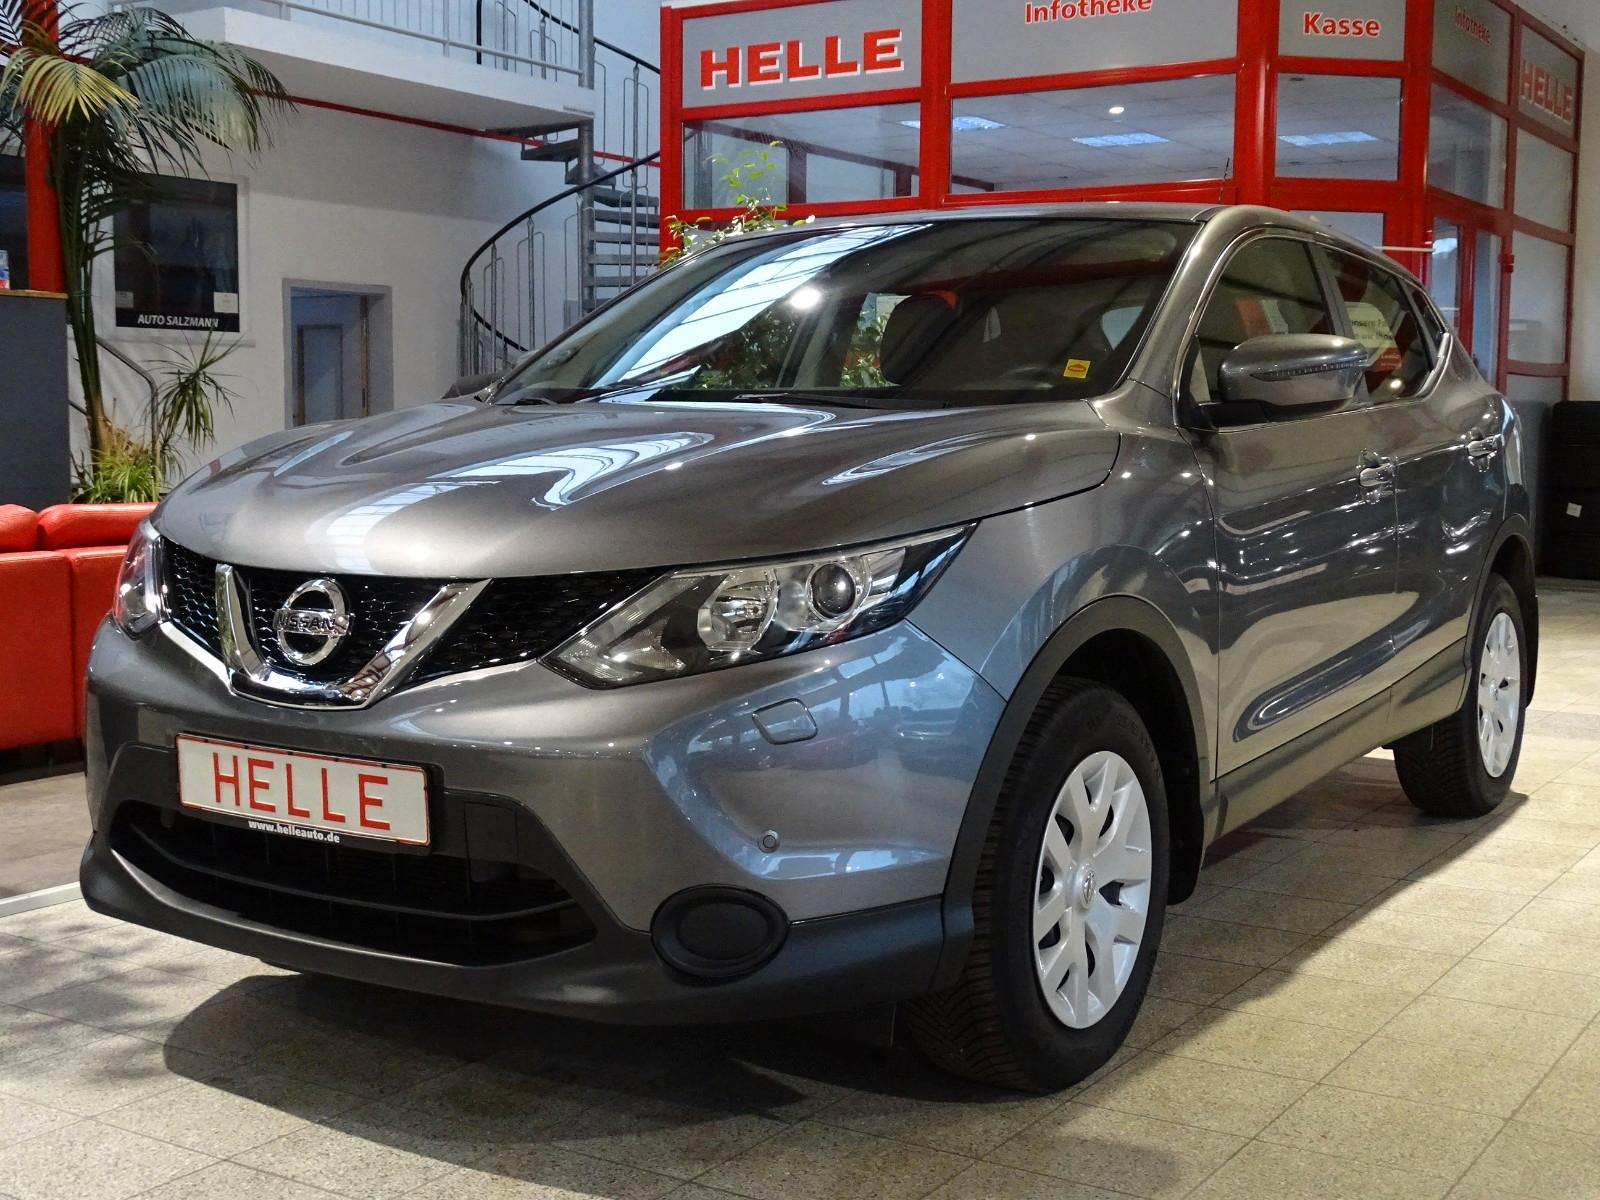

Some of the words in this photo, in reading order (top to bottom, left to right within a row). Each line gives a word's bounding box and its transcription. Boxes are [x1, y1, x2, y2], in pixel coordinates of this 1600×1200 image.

[1025, 0, 1152, 24] Infotheke
[1303, 11, 1380, 37] Kasse
[701, 28, 904, 90] HELLE
[1519, 60, 1573, 125] HELLE
[137, 313, 165, 325] AUTO
[166, 315, 219, 328] SALZMANN
[279, 613, 337, 631] NISSAN
[212, 751, 391, 831] HELLE
[247, 820, 341, 844] www.helleauto.de
